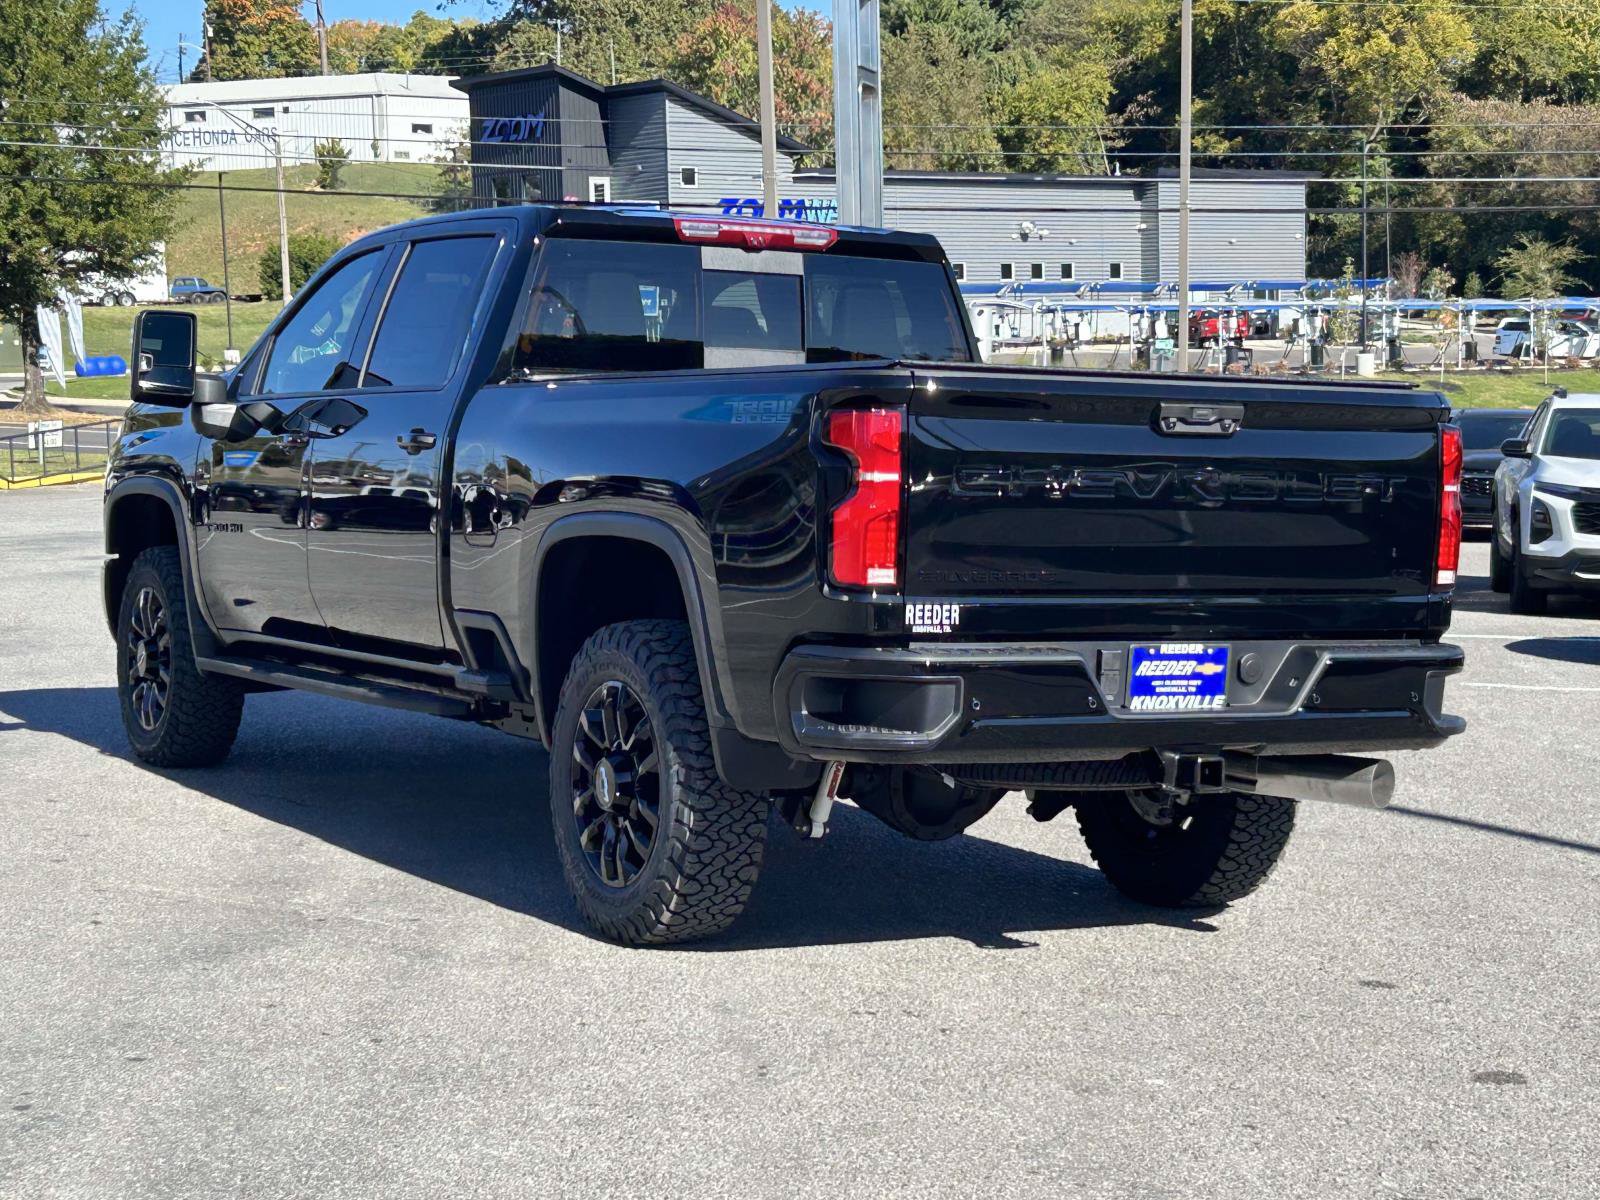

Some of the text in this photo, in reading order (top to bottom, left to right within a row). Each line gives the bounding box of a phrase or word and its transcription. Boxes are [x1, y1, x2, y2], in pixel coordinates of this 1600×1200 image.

[481, 112, 545, 142] ZOOM
[723, 400, 792, 414] TRAIL
[951, 463, 1408, 504] CHEVROLET
[905, 604, 960, 625] REEDER
[1160, 644, 1205, 655] REEDER
[1135, 660, 1198, 676] REEDER
[1130, 695, 1226, 710] KNOXVILLE
